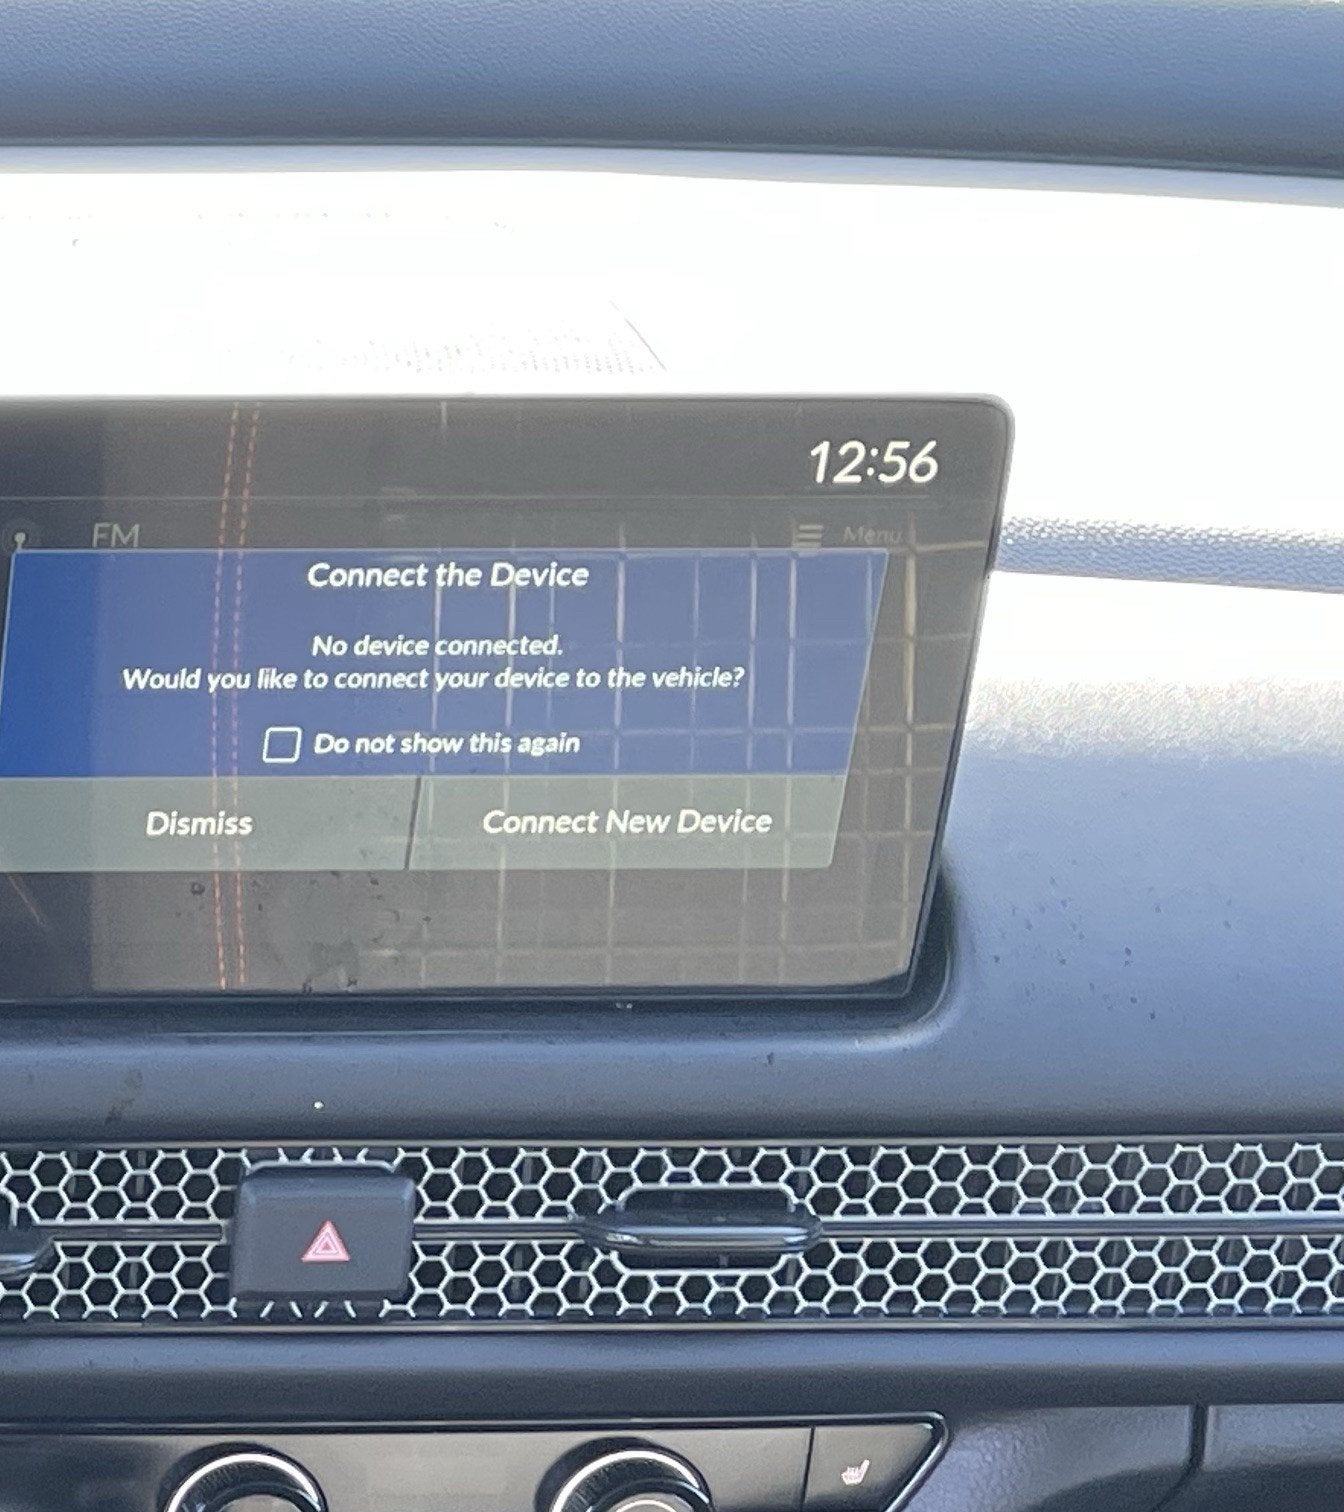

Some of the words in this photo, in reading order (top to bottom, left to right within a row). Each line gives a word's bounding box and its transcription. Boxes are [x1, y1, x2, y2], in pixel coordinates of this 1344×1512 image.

[810, 439, 939, 485] 12:56
[91, 522, 141, 548] FM
[843, 526, 902, 545] Menu
[307, 562, 428, 588] Connect
[435, 562, 483, 587] the
[490, 561, 590, 588] Device
[312, 635, 348, 657] No
[353, 634, 429, 657] device
[434, 633, 564, 657] connected.
[122, 667, 201, 690] Would
[207, 674, 251, 695] you
[257, 667, 297, 690] like
[304, 670, 328, 690] to
[334, 669, 428, 690] connect
[434, 673, 490, 695] your
[494, 666, 571, 689] device
[576, 669, 600, 689] to
[607, 667, 645, 689] the
[651, 666, 745, 689] vehicle?
[314, 733, 350, 756] Do
[355, 734, 396, 756] not
[400, 732, 464, 755] show
[469, 733, 512, 755] this
[517, 735, 581, 758] again
[146, 810, 253, 837] Dismiss
[482, 809, 597, 836] Connect
[606, 810, 670, 835] New
[676, 809, 773, 836] Device
